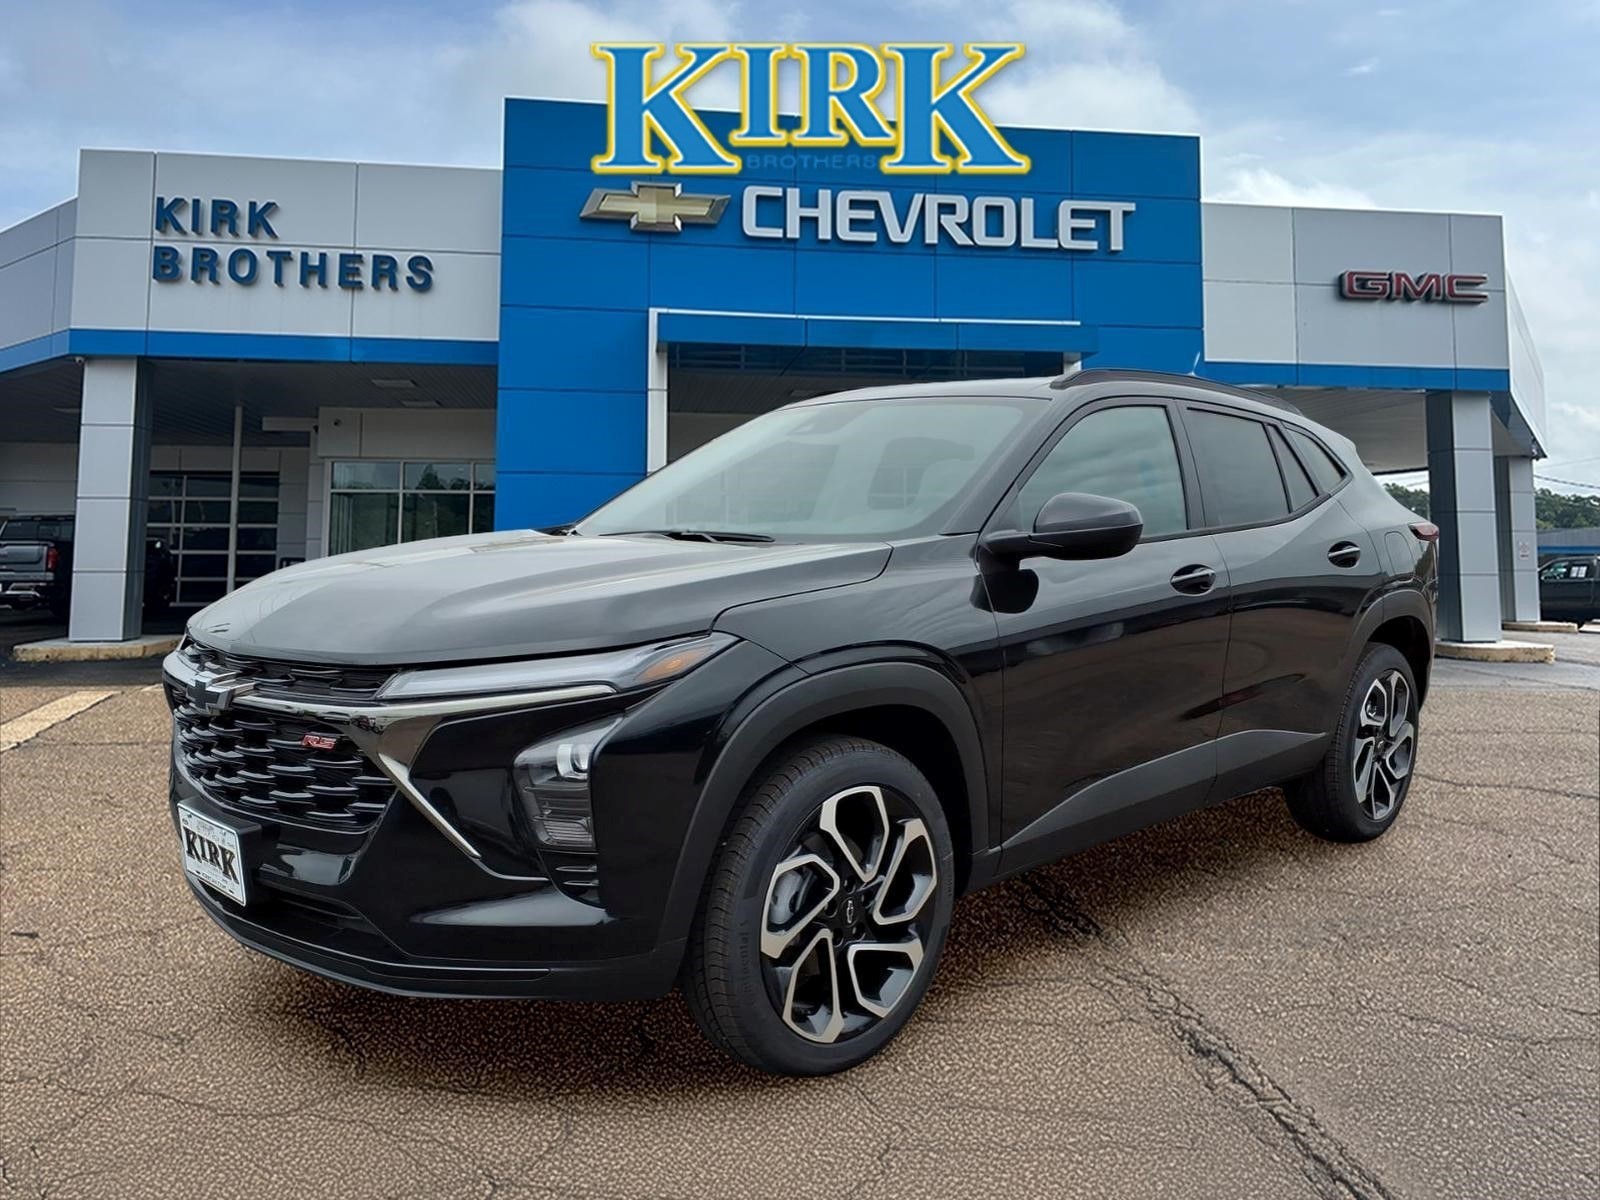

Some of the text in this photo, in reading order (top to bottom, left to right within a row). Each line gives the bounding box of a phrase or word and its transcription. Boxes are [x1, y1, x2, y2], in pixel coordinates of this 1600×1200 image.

[154, 196, 279, 239] KIRK
[742, 185, 1136, 251] CHEVROLET
[152, 245, 434, 293] BROTHERS
[1339, 270, 1489, 304] GMC
[303, 734, 337, 749] RS
[183, 826, 240, 885] KIRK
